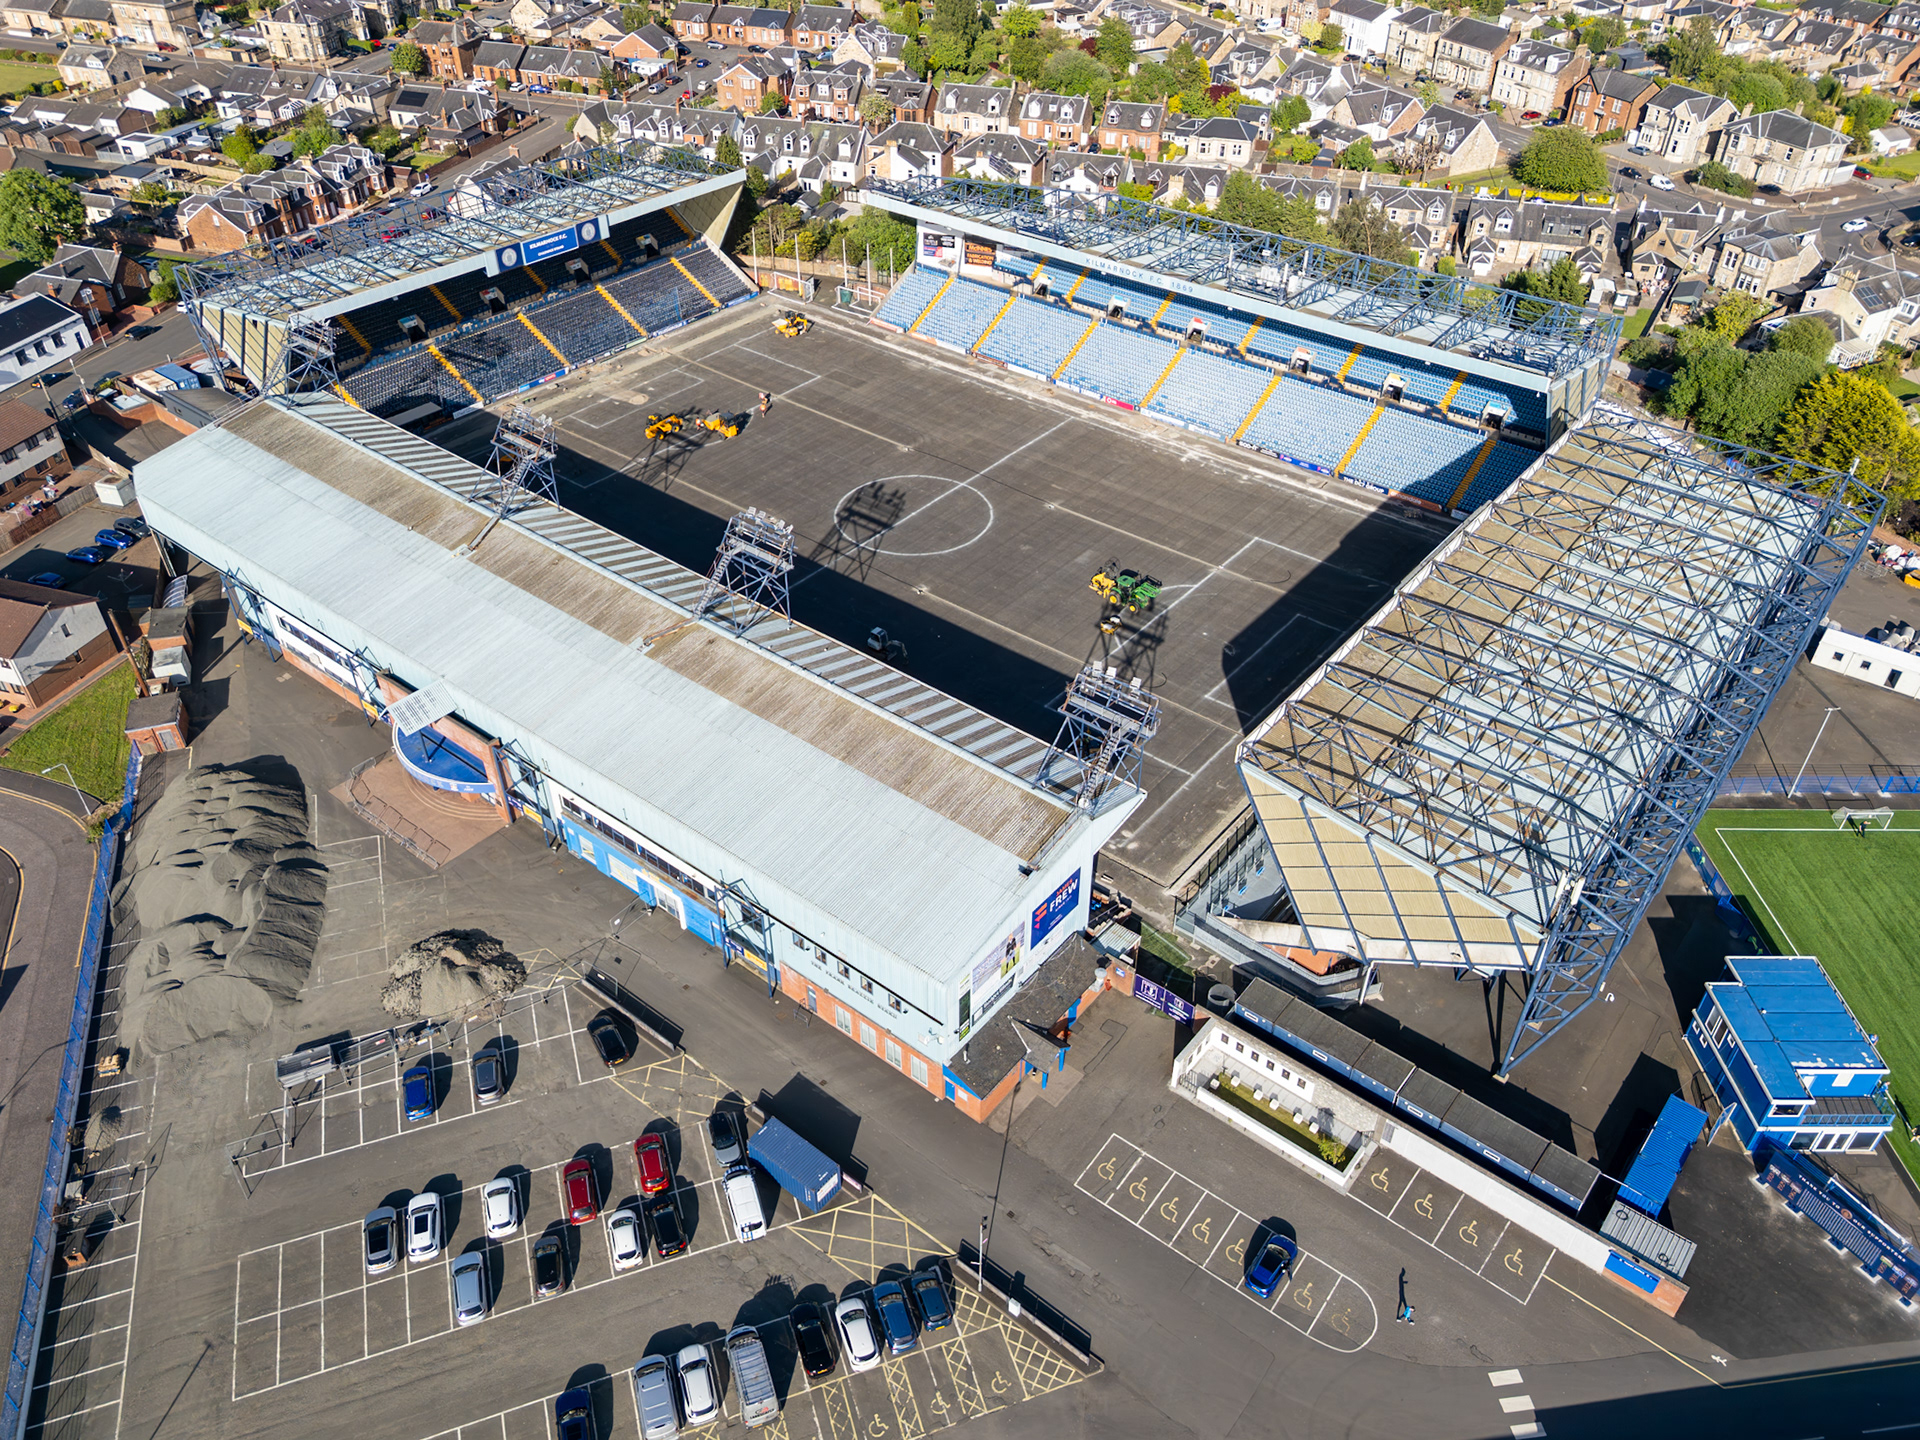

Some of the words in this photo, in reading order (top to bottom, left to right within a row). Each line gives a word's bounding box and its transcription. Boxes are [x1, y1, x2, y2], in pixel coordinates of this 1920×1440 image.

[529, 236, 559, 250] KILMARNOCK
[1085, 257, 1144, 280] KILMARNOCK
[1171, 281, 1194, 293] 1869
[1049, 878, 1078, 912] FREW
[1798, 1174, 1818, 1191] THANK
[1818, 1190, 1830, 1202] YOU
[1831, 1201, 1841, 1210] TO
[1852, 1218, 1866, 1230] OUR
[1866, 1230, 1907, 1263] SUPPORTERS
